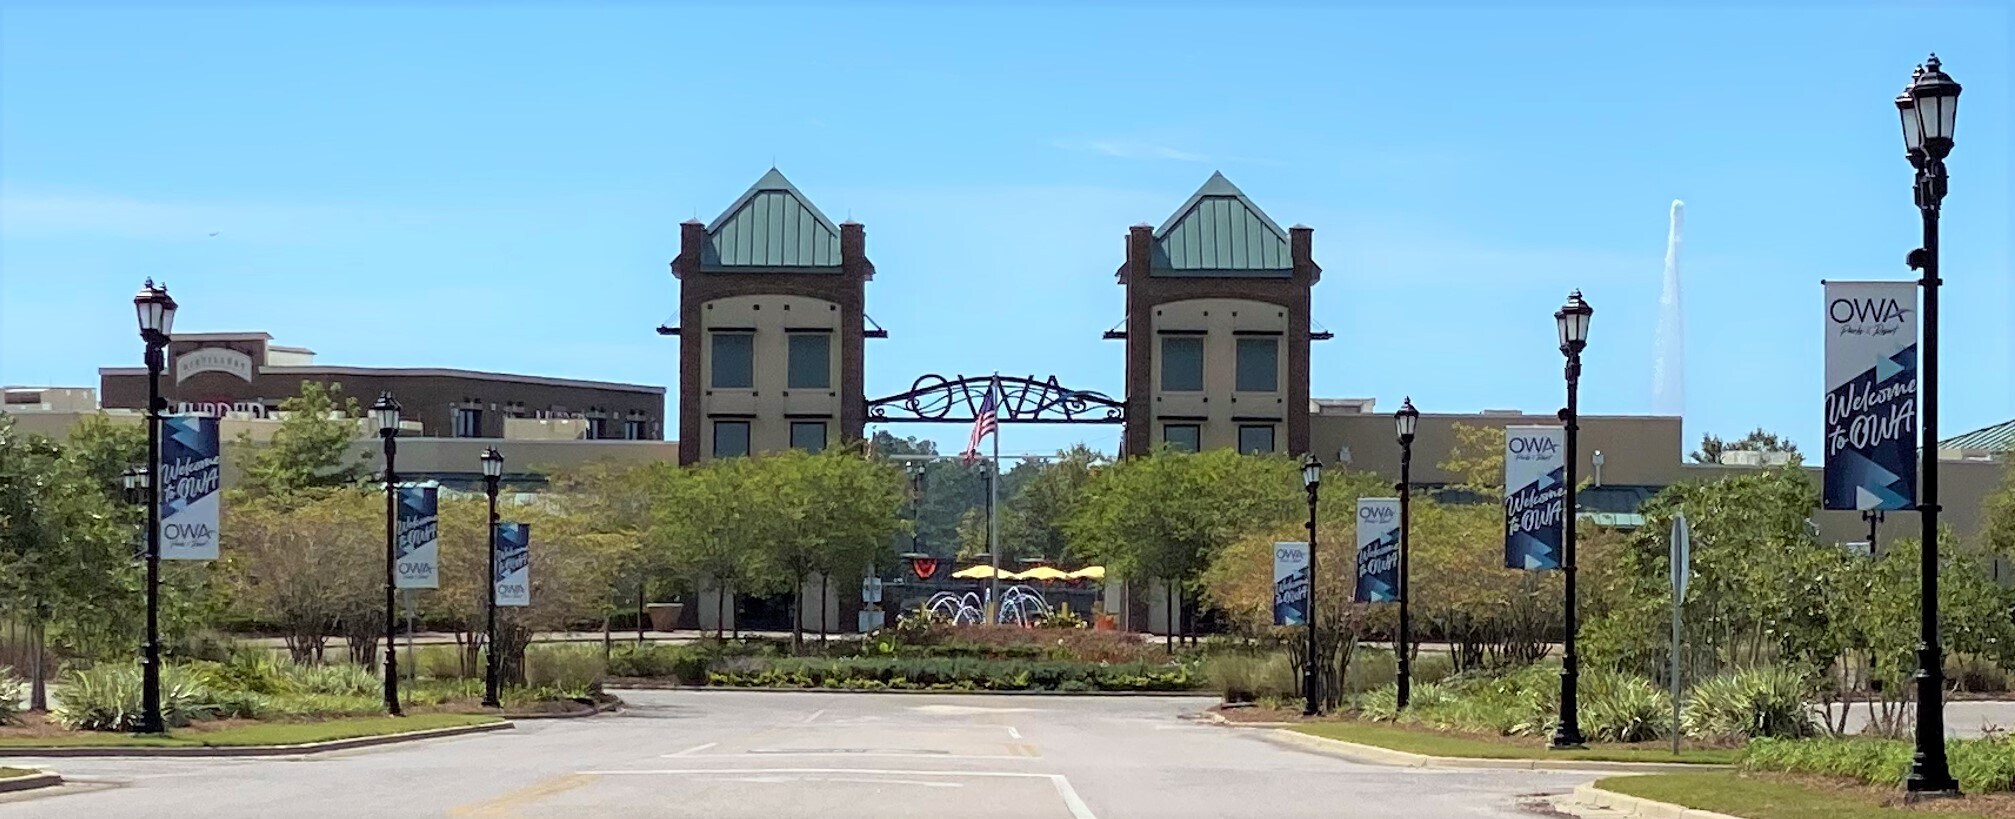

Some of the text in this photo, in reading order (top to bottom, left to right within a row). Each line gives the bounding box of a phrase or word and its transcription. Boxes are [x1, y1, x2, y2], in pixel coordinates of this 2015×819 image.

[1830, 298, 1913, 323] OWA
[909, 374, 1074, 421] OWA
[1826, 378, 1916, 425] Welcome
[1829, 399, 1915, 456] to OWA
[1509, 437, 1560, 453] OWA
[161, 456, 219, 483] Welcome
[177, 468, 218, 498] OWA
[1360, 506, 1395, 519] OWA
[1506, 487, 1565, 516] Welcome
[1521, 500, 1562, 532] OWA
[165, 524, 214, 540] OWA
[399, 563, 433, 574] OWA
